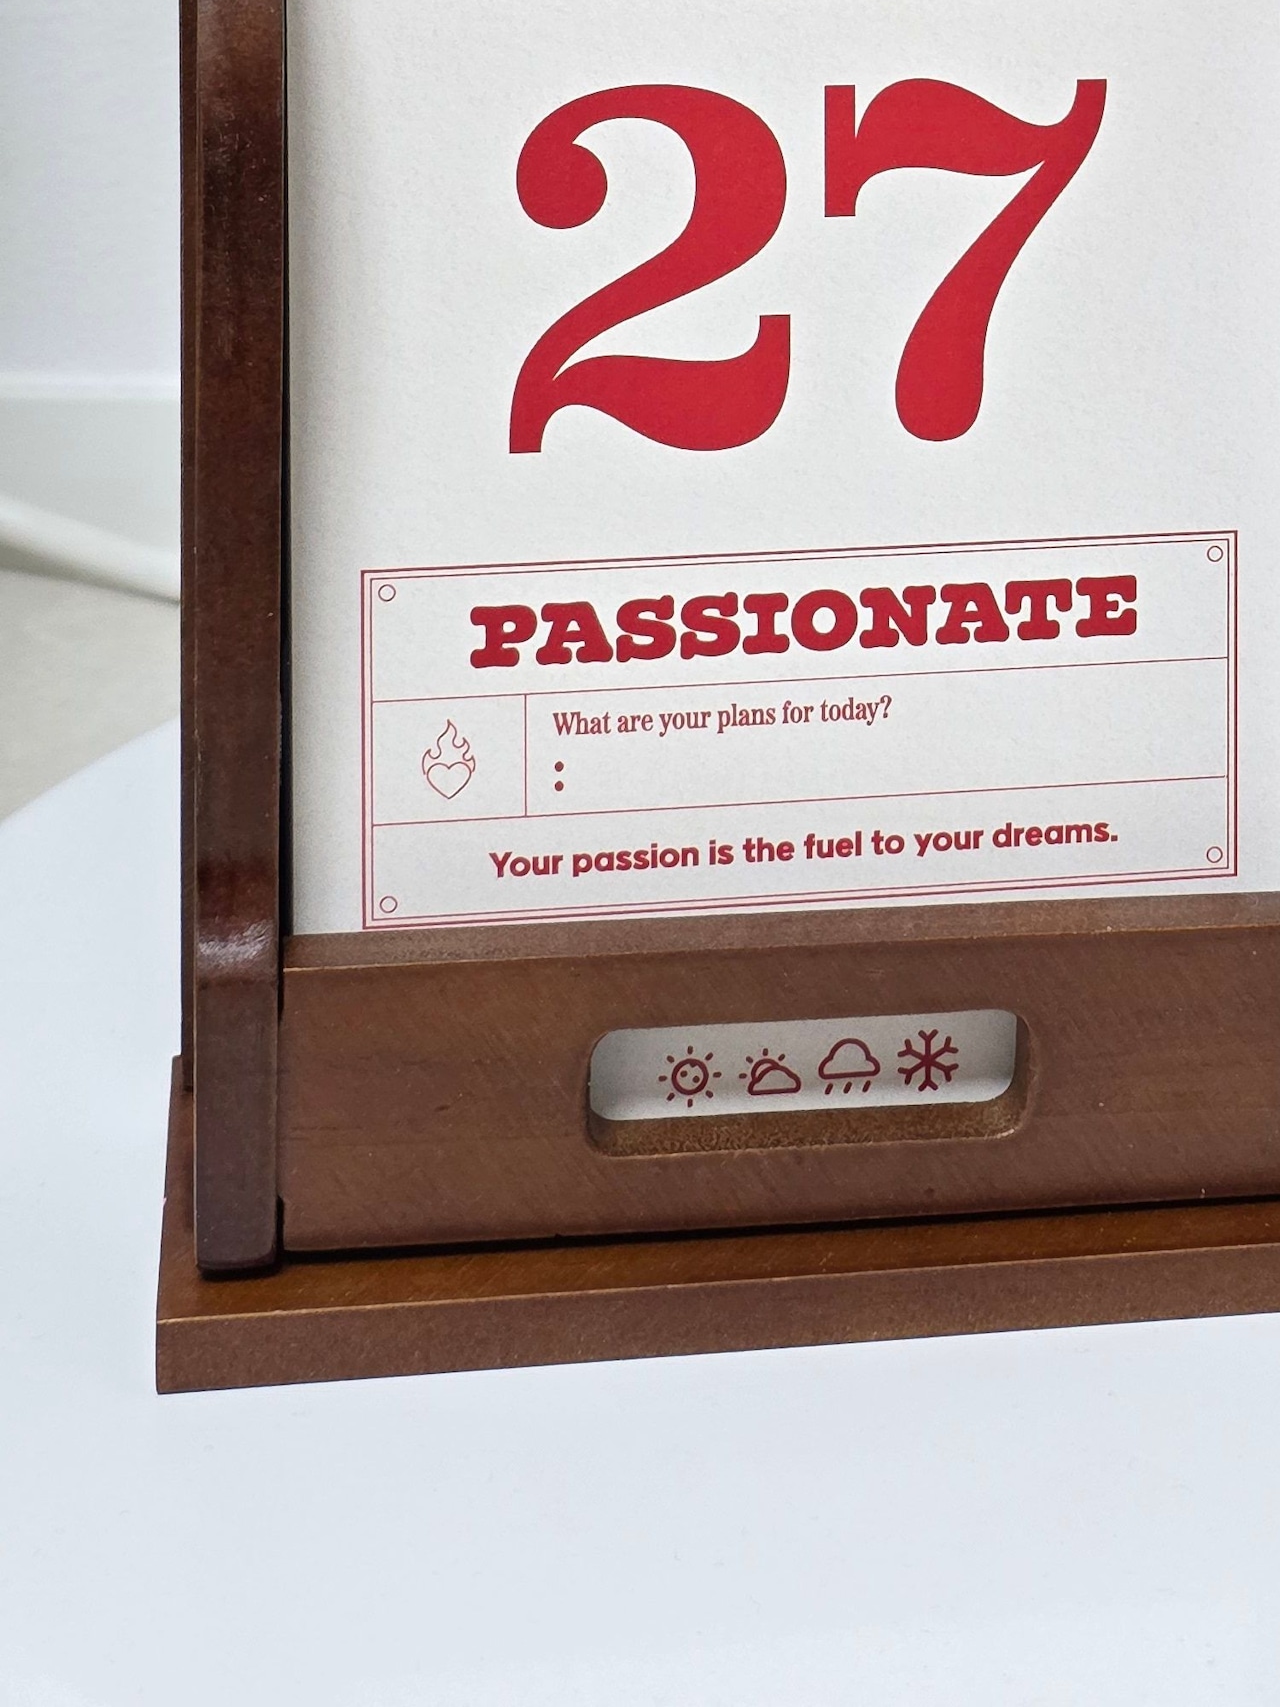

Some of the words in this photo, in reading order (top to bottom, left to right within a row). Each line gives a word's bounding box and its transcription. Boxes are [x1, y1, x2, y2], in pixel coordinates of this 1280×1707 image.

[509, 78, 1108, 454] 27
[470, 574, 1139, 669] PASSIONATE
[553, 710, 612, 736] What
[617, 713, 654, 733] are
[658, 709, 712, 737] your
[717, 703, 776, 733] plans
[782, 699, 815, 725] for
[820, 694, 893, 726] today?
[489, 851, 563, 879] Your
[571, 843, 700, 878] passion
[708, 841, 735, 866] is
[741, 837, 796, 864] the
[803, 830, 863, 860] fuel
[870, 830, 906, 856] to
[914, 828, 986, 859] your
[992, 820, 1120, 850] dreams.
